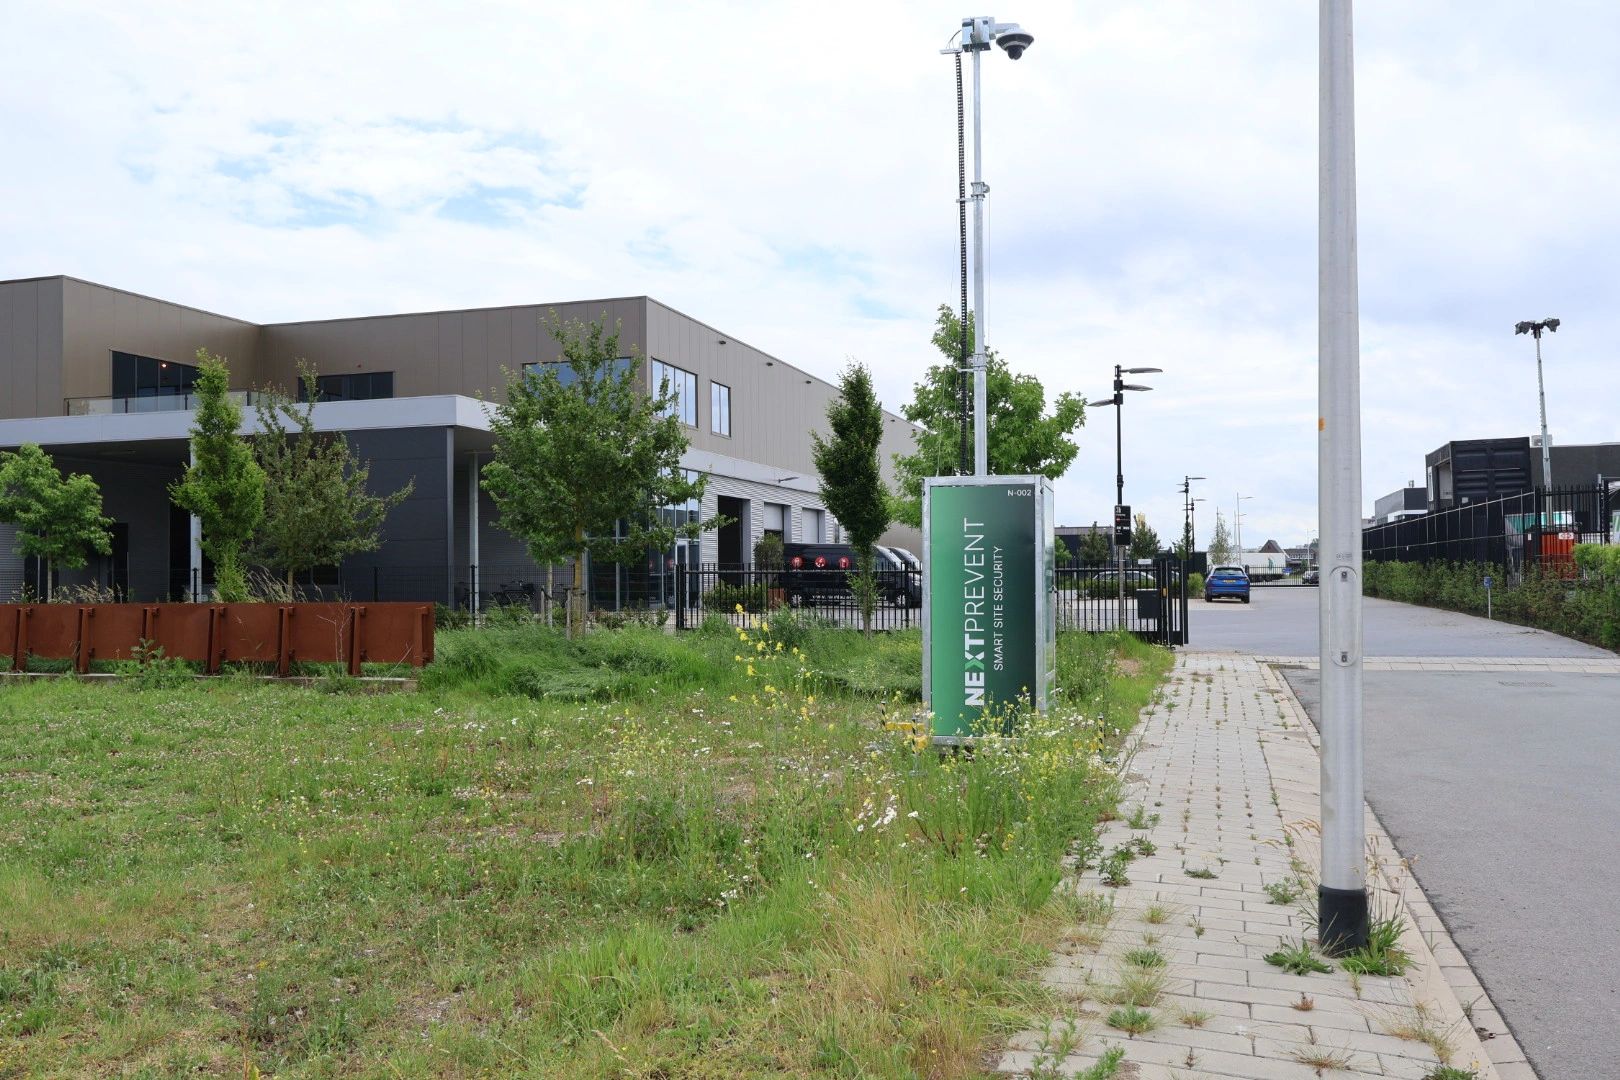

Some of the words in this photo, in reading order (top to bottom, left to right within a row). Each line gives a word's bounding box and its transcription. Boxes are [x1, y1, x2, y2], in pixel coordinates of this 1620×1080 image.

[1007, 489, 1032, 497] N-002
[993, 545, 1004, 601] SECURITY
[963, 517, 985, 706] NEXTPREVENT
[993, 604, 1004, 629] SITE
[993, 631, 1004, 671] SMART
